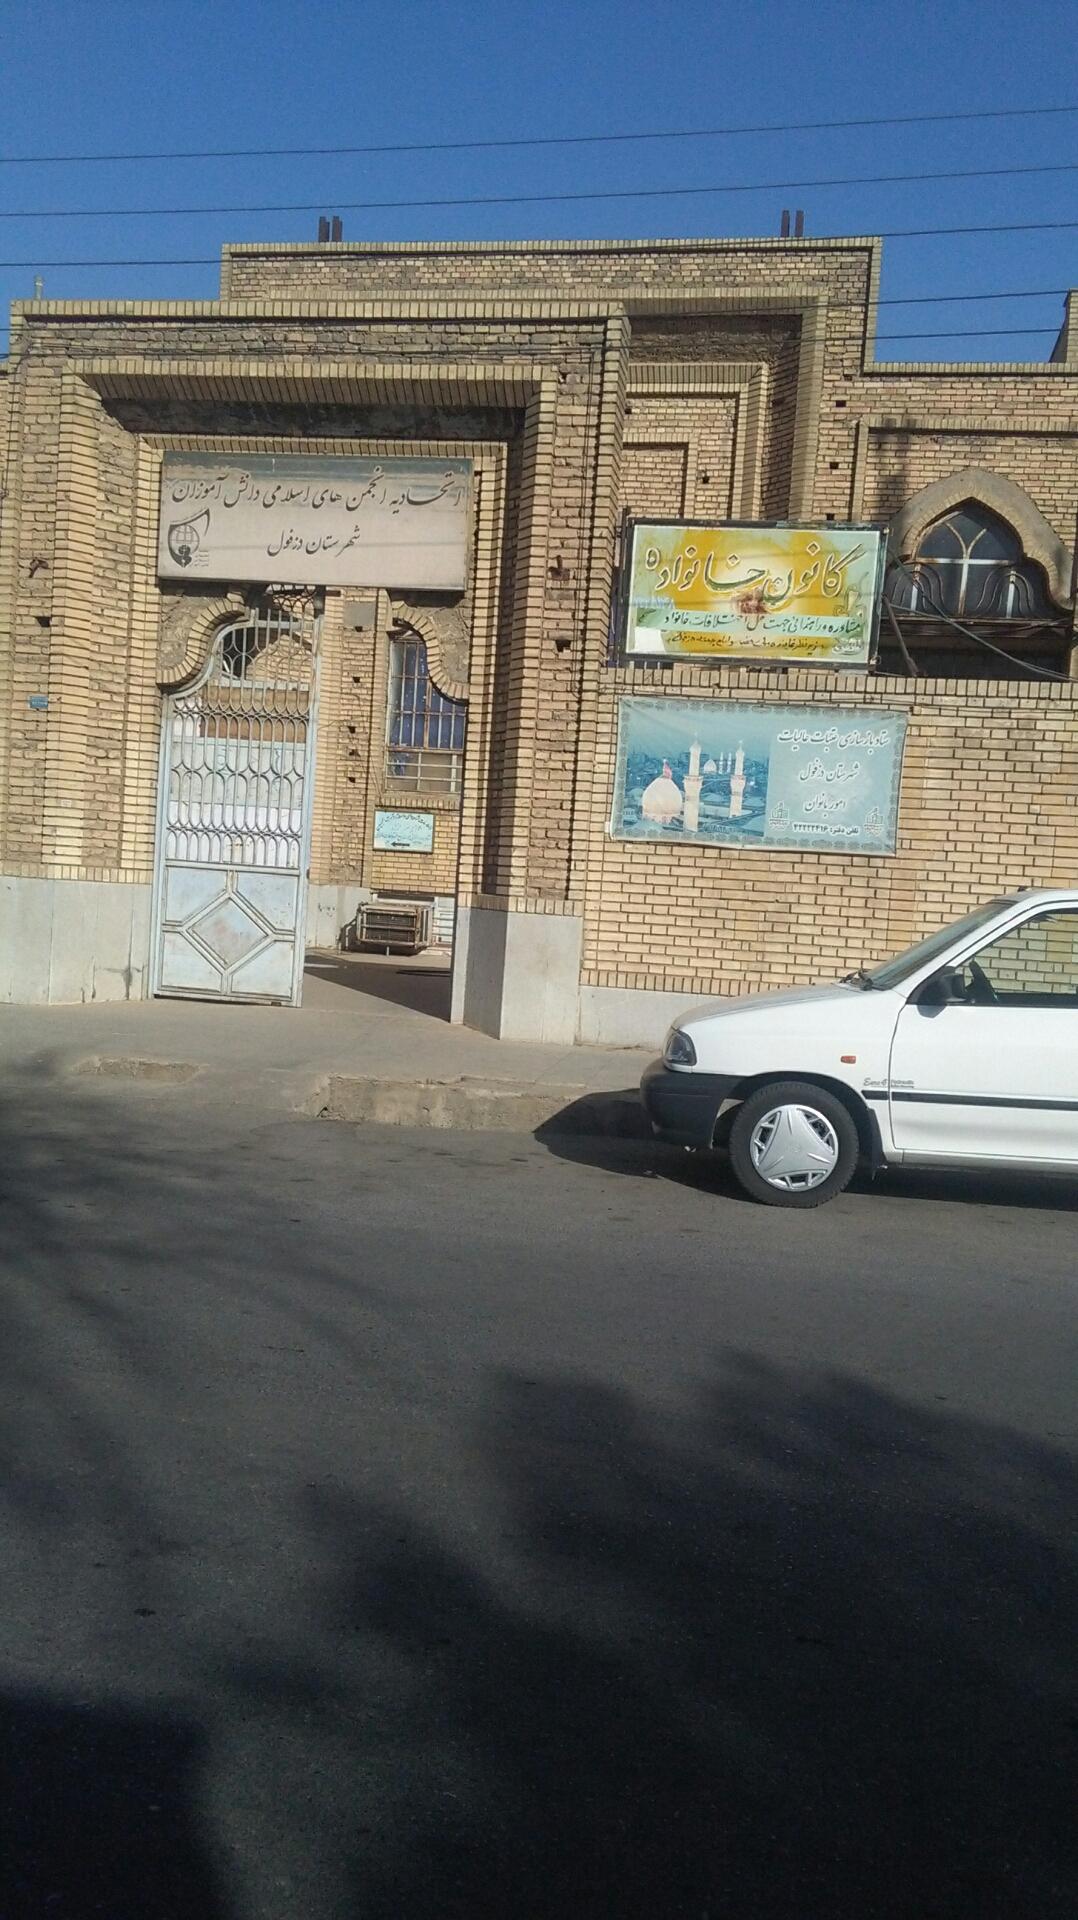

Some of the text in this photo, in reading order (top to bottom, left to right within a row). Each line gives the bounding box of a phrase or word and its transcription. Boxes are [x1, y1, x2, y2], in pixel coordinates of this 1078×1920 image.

[172, 467, 461, 514] اتحادیه انجمن های اسلامی دانش آموزان
[267, 525, 361, 557] شهرستان دزفول
[645, 541, 866, 608] کانون خانواده
[763, 618, 790, 632] جهت
[828, 617, 862, 633] مشاوره
[778, 728, 889, 754] ستاد بازسازی عتبات عالیات
[800, 759, 859, 782] شهرستان دزفول
[804, 793, 846, 817] امور بانوان
